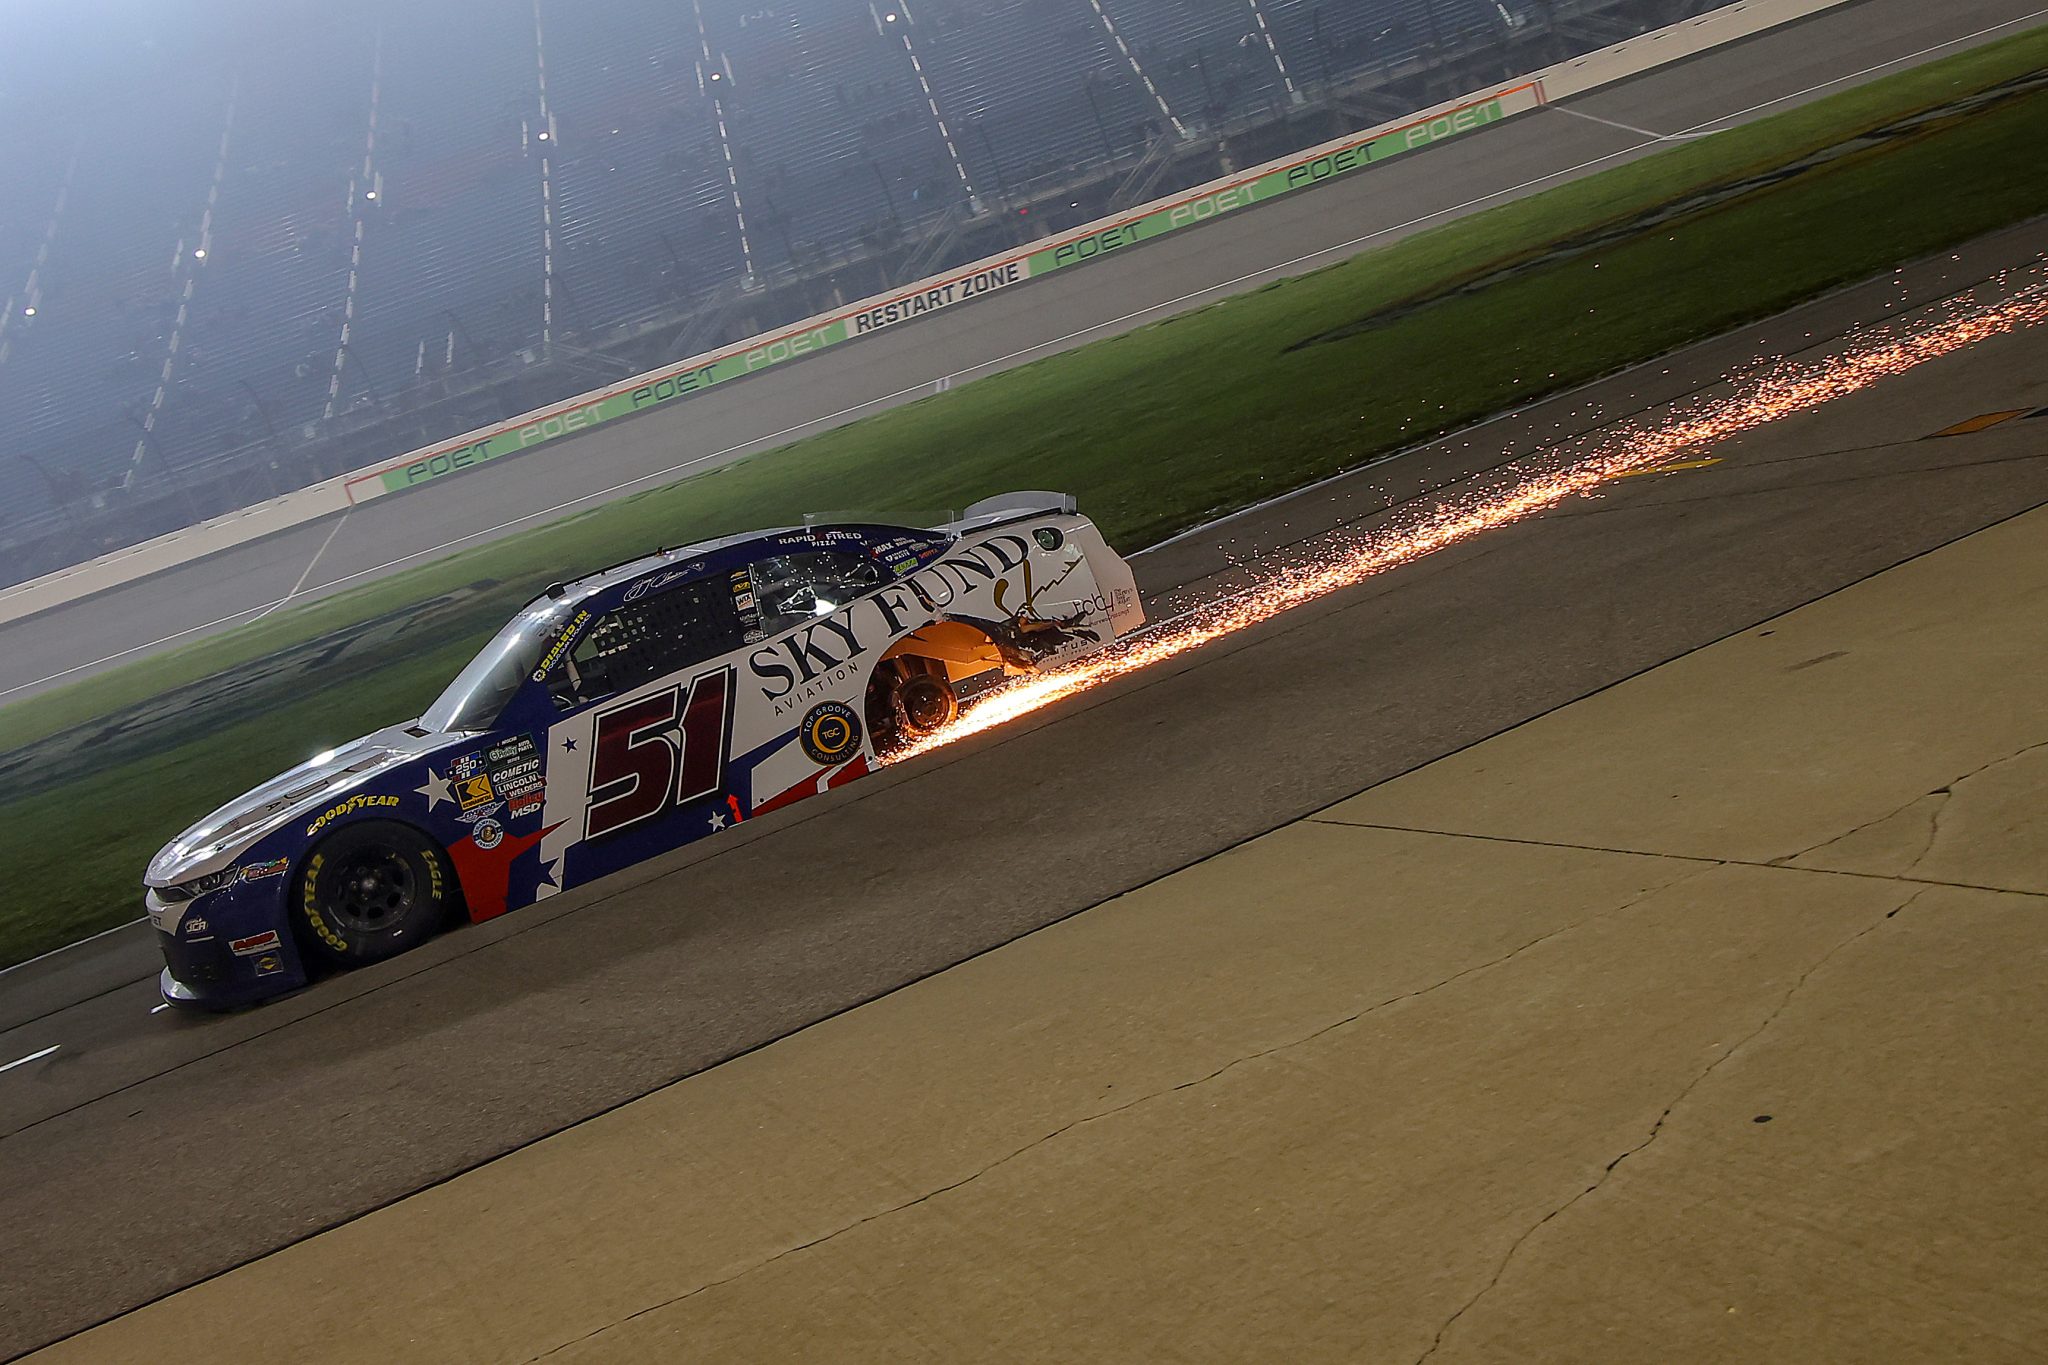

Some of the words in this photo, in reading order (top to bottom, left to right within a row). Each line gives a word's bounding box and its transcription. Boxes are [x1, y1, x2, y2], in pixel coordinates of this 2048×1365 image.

[1404, 102, 1497, 149] POET
[1287, 141, 1377, 188] POET
[1170, 181, 1261, 228] POET
[1054, 221, 1142, 266] POET
[855, 283, 955, 333] RESTART
[961, 263, 1019, 298] ZONE
[745, 326, 831, 371] POET
[632, 364, 718, 408] POET
[519, 402, 603, 447] POET
[405, 440, 493, 484] POET
[778, 534, 816, 545] RAPID
[825, 532, 862, 541] FIRED
[811, 539, 837, 547] PIZZA
[540, 623, 576, 669] DIALED
[574, 609, 588, 624] IN
[748, 605, 868, 702] SKY
[865, 535, 1029, 638] FUND
[774, 662, 859, 718] AVIATION
[803, 715, 815, 732] TOP
[815, 705, 852, 718] GROOVE
[821, 727, 841, 740] TGC
[455, 760, 477, 775] 250
[517, 744, 533, 753] PARTS
[582, 663, 737, 841] 51
[493, 759, 539, 783] COMETIC
[498, 774, 537, 793] LINCOLN
[509, 781, 543, 798] WELDERS
[305, 793, 400, 837] GOODYEAR
[510, 802, 541, 820] MSD
[419, 849, 442, 900] EAGLE
